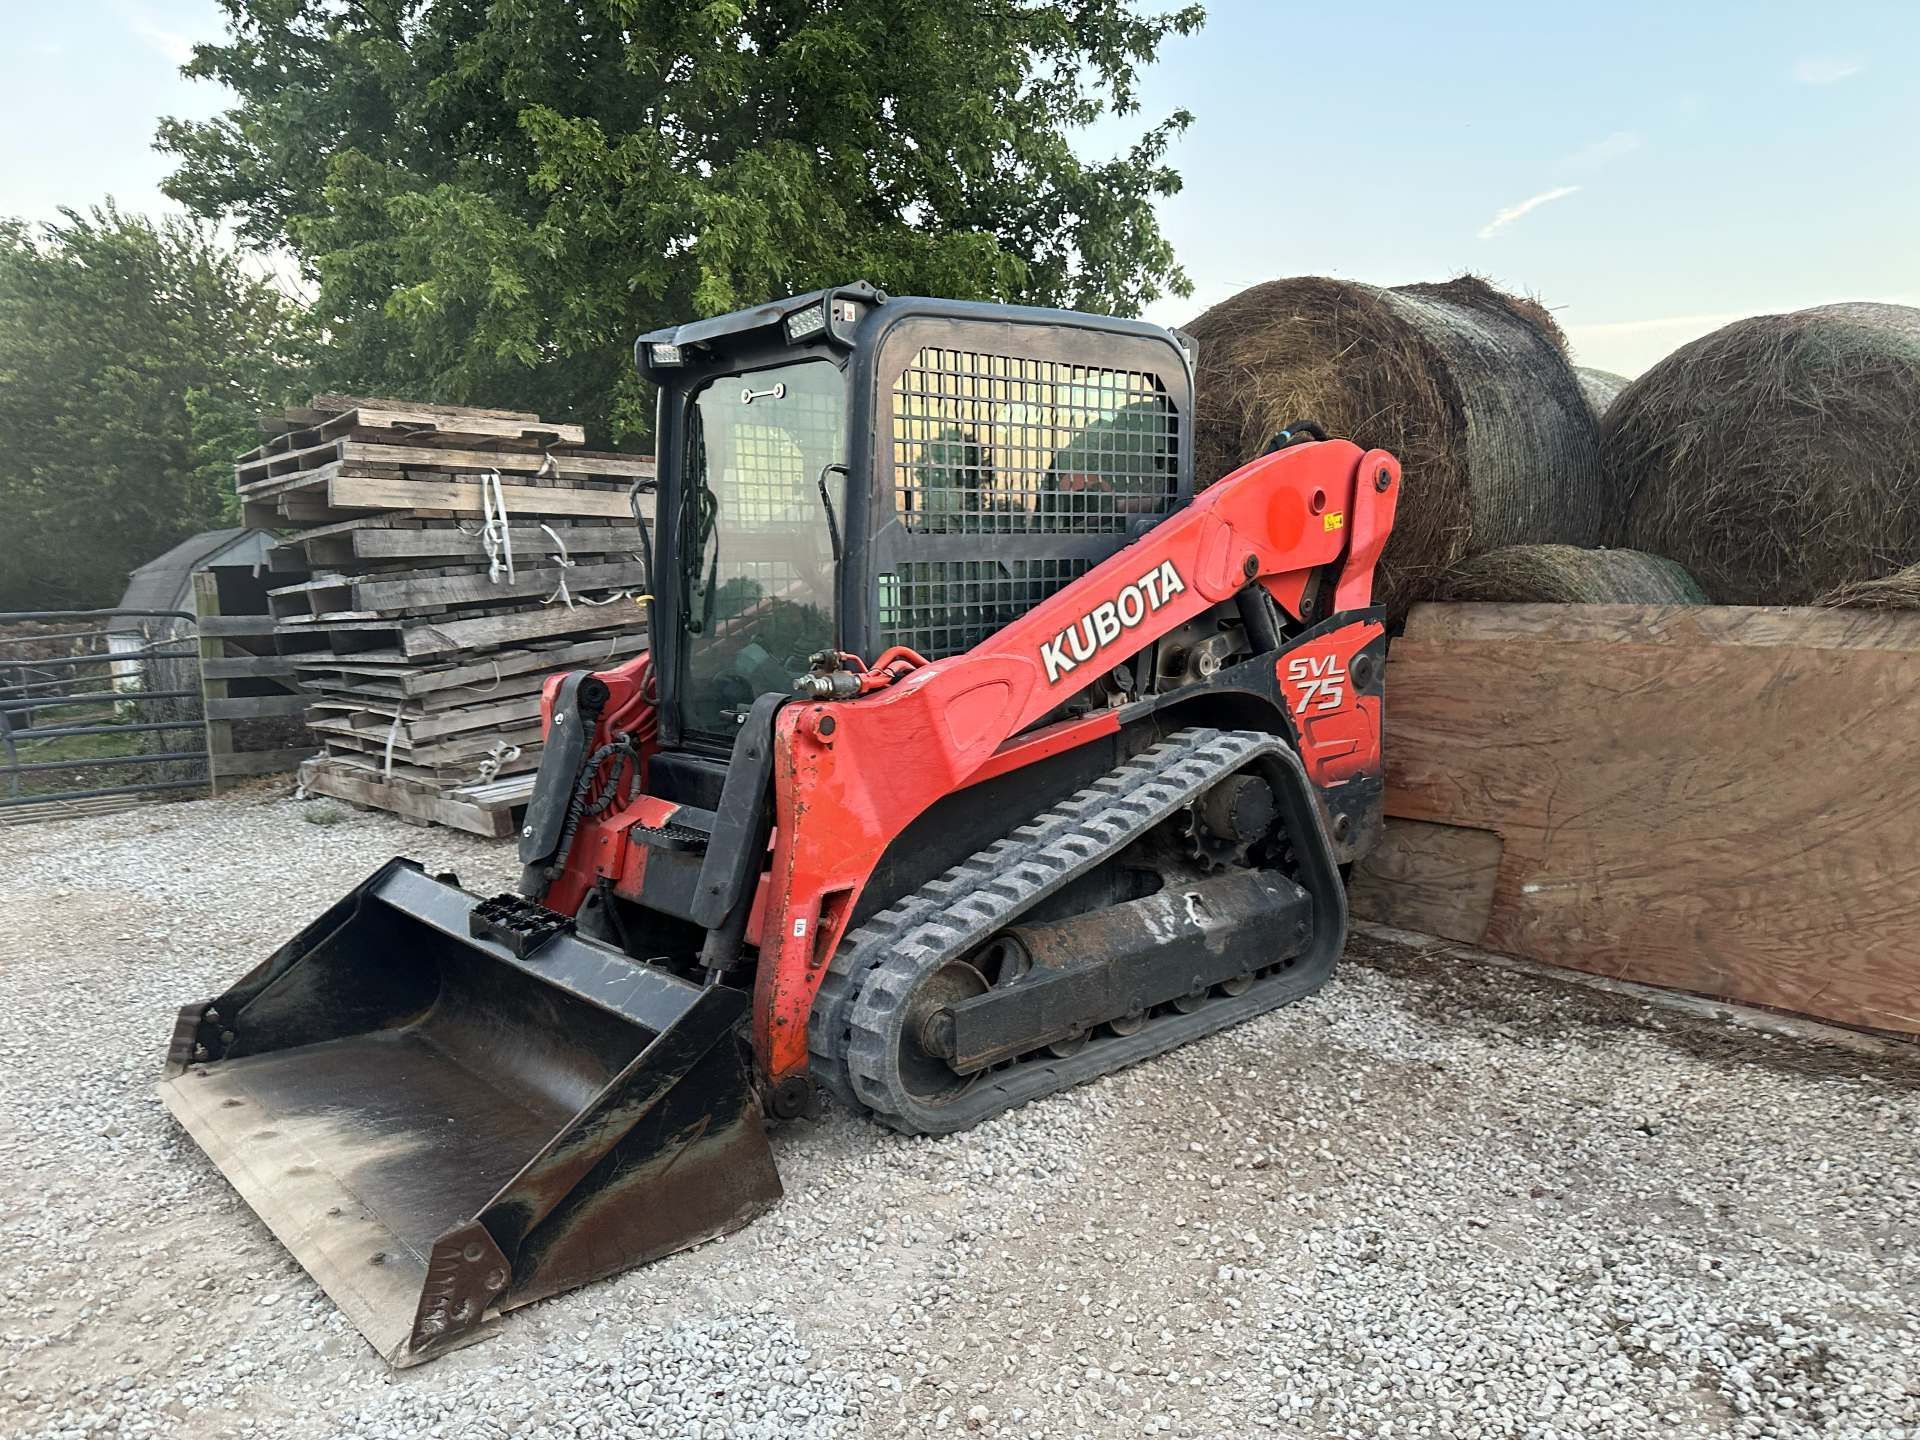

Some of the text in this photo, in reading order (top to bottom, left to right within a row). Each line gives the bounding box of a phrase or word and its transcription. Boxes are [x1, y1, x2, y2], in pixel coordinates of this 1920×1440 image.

[1040, 560, 1185, 683] KUBOTA
[1288, 654, 1346, 681] SVL
[1296, 677, 1345, 713] 75
